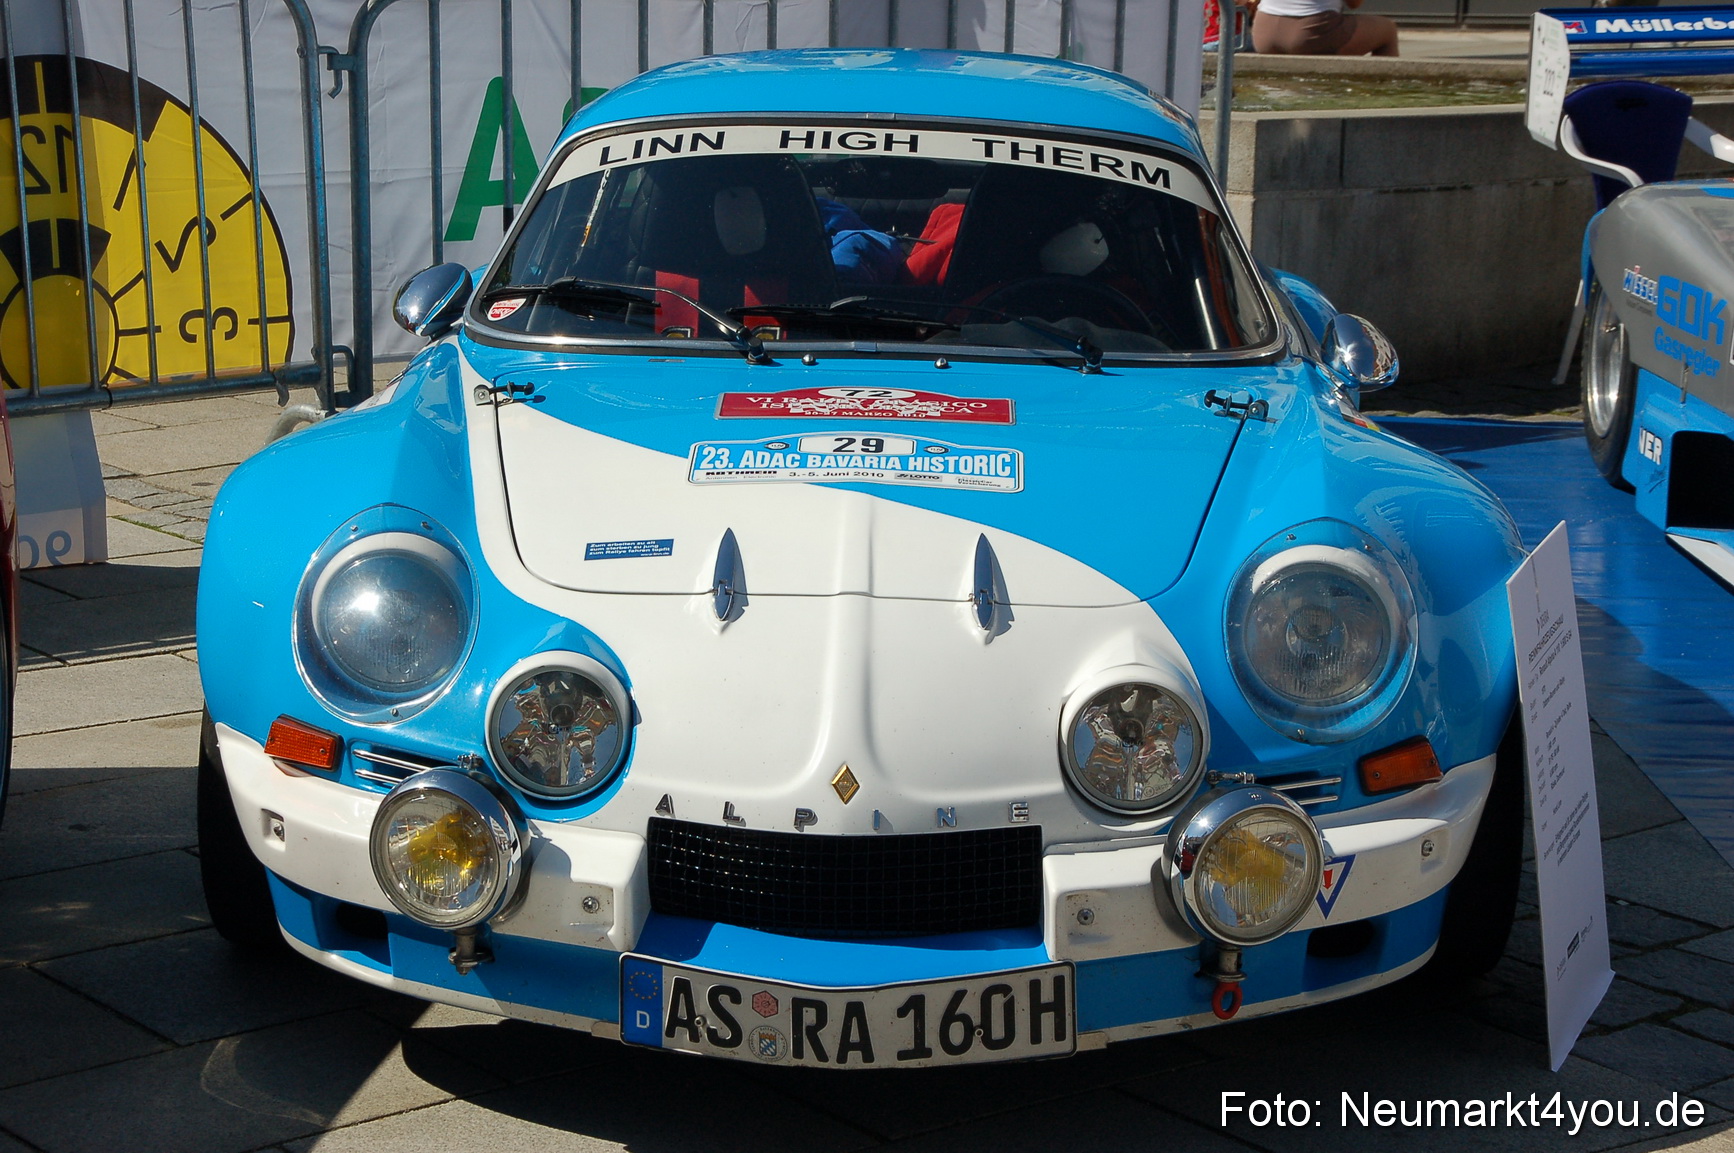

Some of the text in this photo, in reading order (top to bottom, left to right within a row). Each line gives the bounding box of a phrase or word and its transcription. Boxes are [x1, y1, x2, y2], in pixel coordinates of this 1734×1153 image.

[598, 130, 1172, 190] LINN HIGH THERM
[1655, 274, 1728, 345] GOK
[1653, 325, 1722, 379] Gasregler
[840, 389, 893, 398] 72
[699, 446, 1012, 477] 23. ADAC BAVARIA HISTORIC
[832, 437, 885, 453] 29
[654, 792, 1030, 833] ALPINE
[636, 1009, 651, 1029] D
[665, 976, 743, 1049] AS
[790, 996, 875, 1065] RA
[896, 973, 1068, 1062] 160H
